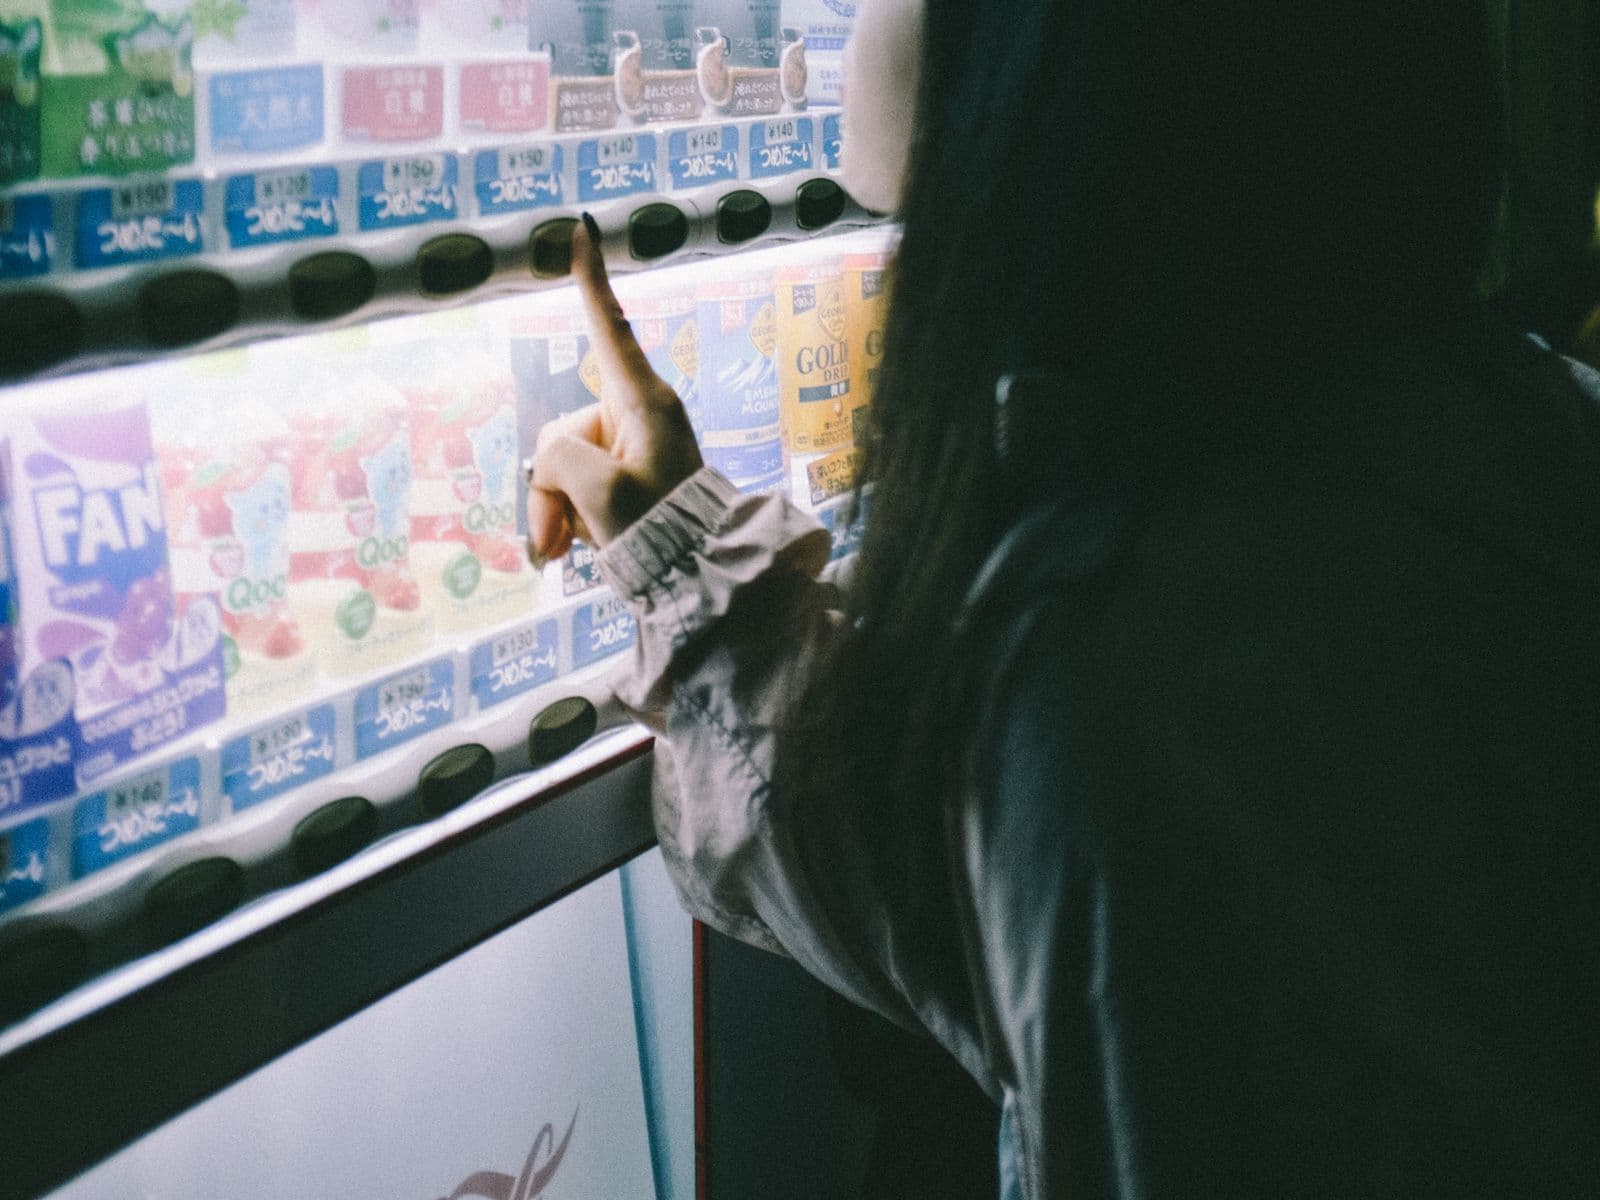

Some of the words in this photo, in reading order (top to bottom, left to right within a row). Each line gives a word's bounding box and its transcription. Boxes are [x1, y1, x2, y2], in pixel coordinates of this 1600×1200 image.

[691, 132, 718, 149] ¥140
[768, 122, 792, 139] ¥140
[603, 137, 634, 157] ¥140
[796, 342, 848, 375] GOLD
[36, 458, 163, 567] FAN
[466, 502, 516, 532] Qoo
[358, 536, 408, 568] Qoo
[226, 575, 286, 611] Qoo
[497, 628, 534, 657] ¥130
[590, 612, 636, 650] つめた
